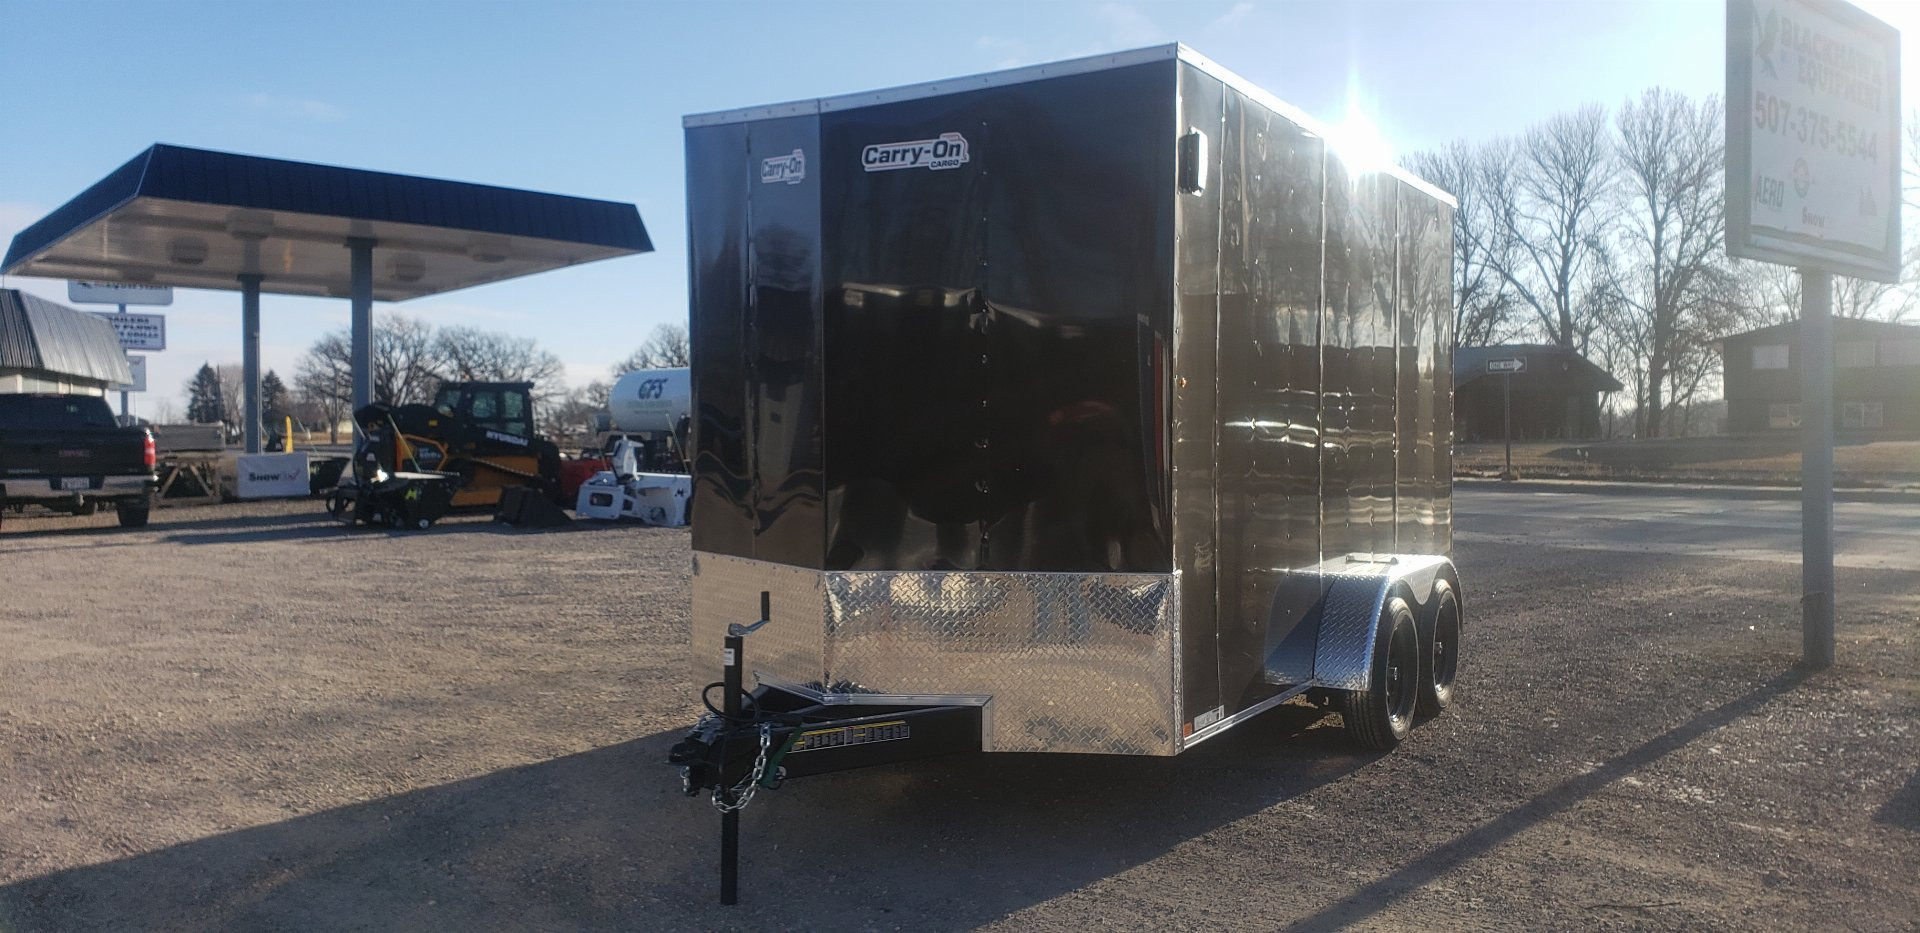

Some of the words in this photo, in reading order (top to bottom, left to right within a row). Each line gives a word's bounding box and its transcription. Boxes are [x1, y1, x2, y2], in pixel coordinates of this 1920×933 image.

[1755, 90, 1877, 164] 507-375-5544
[864, 140, 961, 165] Carry-On
[930, 160, 960, 168] CARGO
[761, 157, 803, 179] Carry-On
